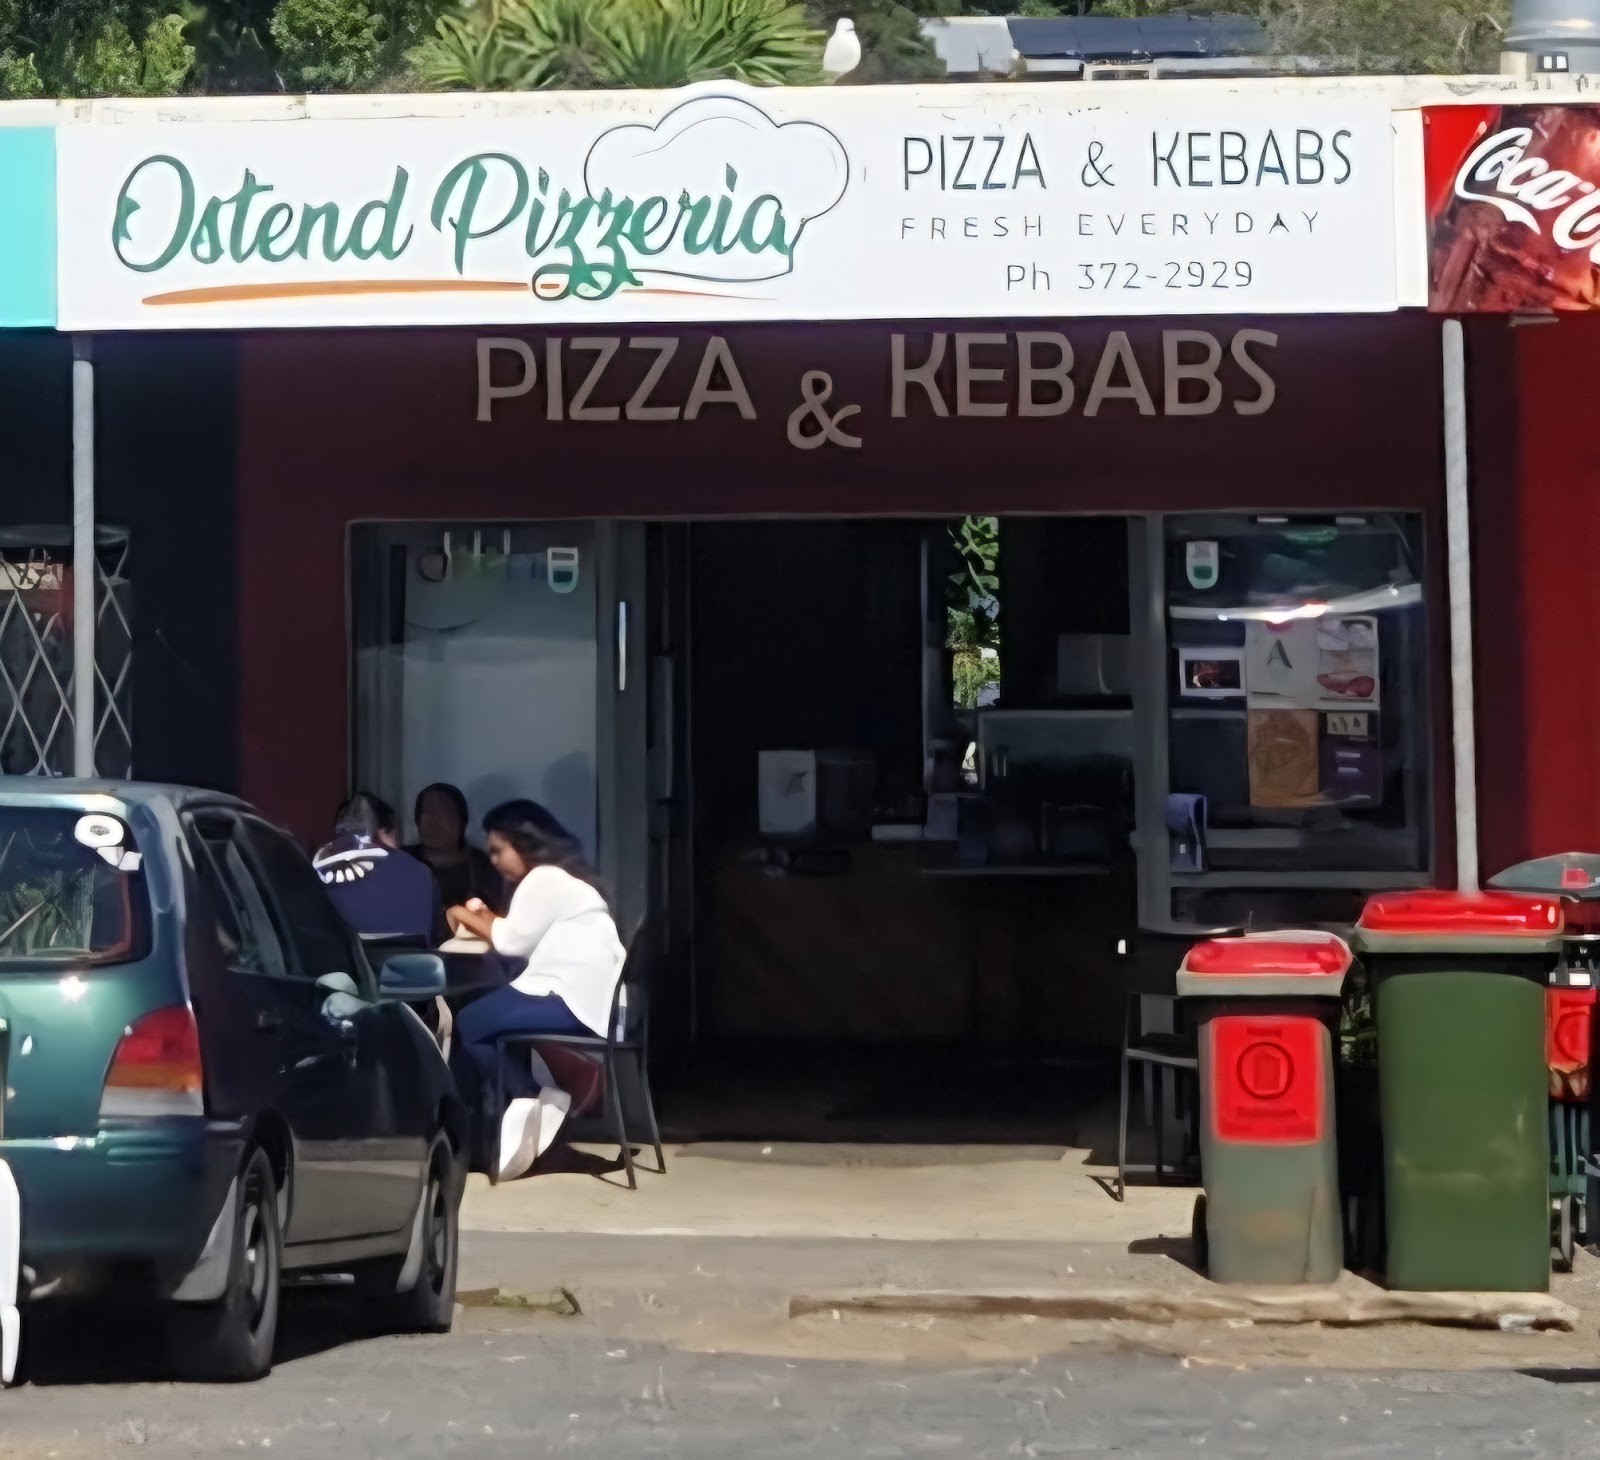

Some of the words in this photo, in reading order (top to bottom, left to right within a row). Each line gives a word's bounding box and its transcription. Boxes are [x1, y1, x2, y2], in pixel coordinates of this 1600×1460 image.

[903, 132, 1047, 191] PIZZA
[1080, 140, 1117, 188] &
[1152, 129, 1352, 188] KEBABS
[1455, 127, 1600, 264] Coca-C
[112, 154, 414, 273] Ostend
[430, 152, 793, 301] Pizzeria
[900, 214, 1042, 240] FRESH
[1078, 211, 1320, 236] EVERYDAY
[1007, 262, 1051, 291] Ph
[1078, 260, 1252, 290] 372-2929
[476, 335, 757, 422] PIZZA
[786, 370, 863, 450] &
[890, 329, 1279, 418] KEBABS
